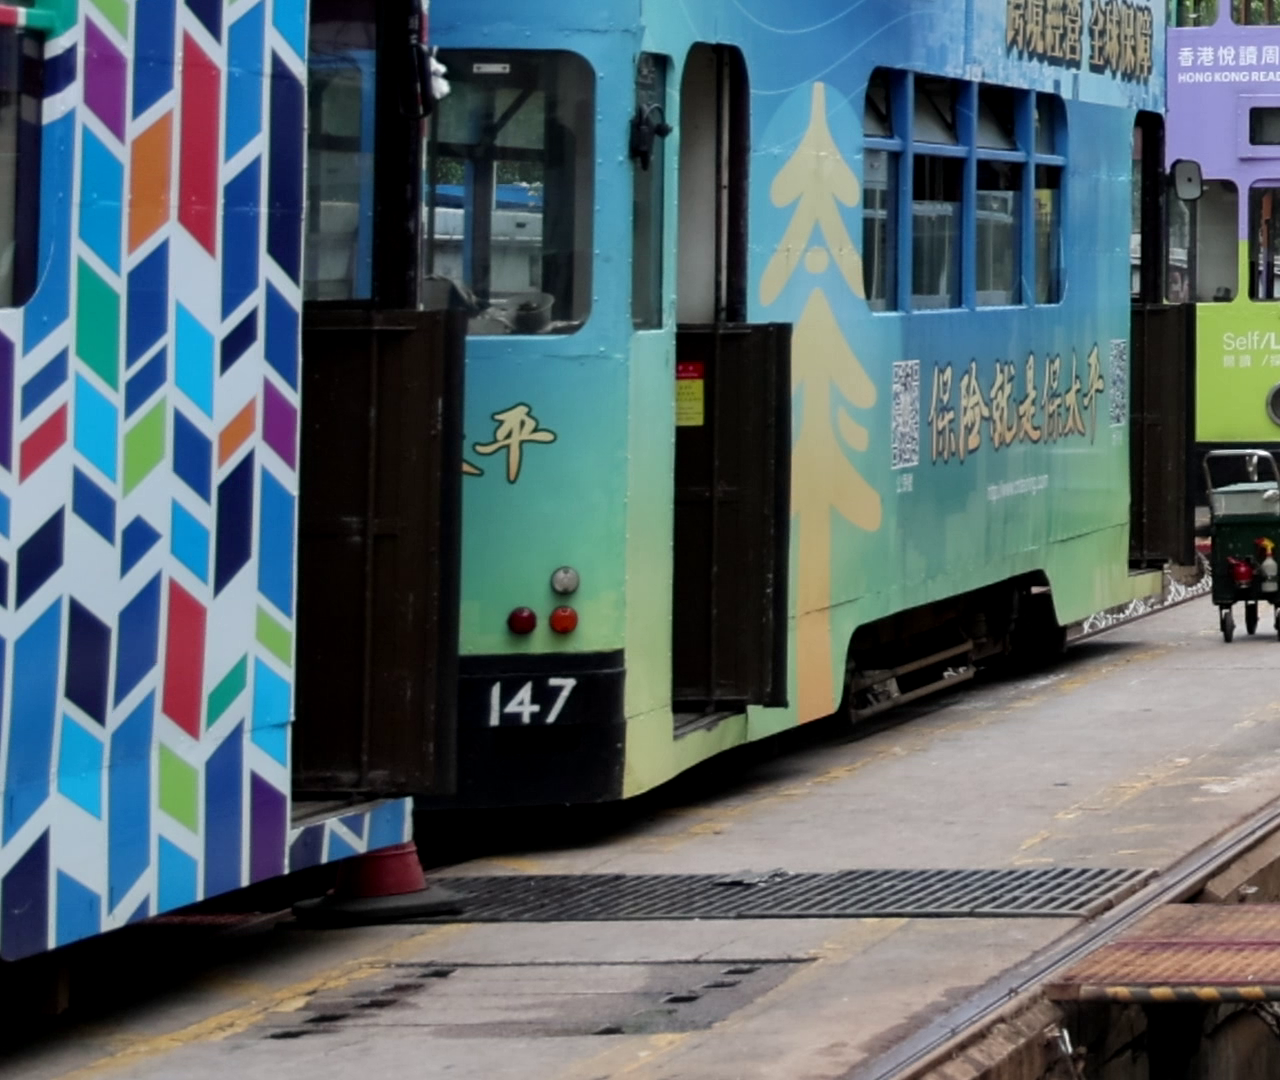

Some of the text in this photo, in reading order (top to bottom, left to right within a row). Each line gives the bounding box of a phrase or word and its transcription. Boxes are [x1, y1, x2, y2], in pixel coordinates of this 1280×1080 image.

[1178, 46, 1279, 67] 香港悅讀周
[1178, 72, 1212, 83] HONG
[1214, 72, 1250, 83] KONG
[464, 402, 557, 484] 平
[489, 678, 577, 727] 147
